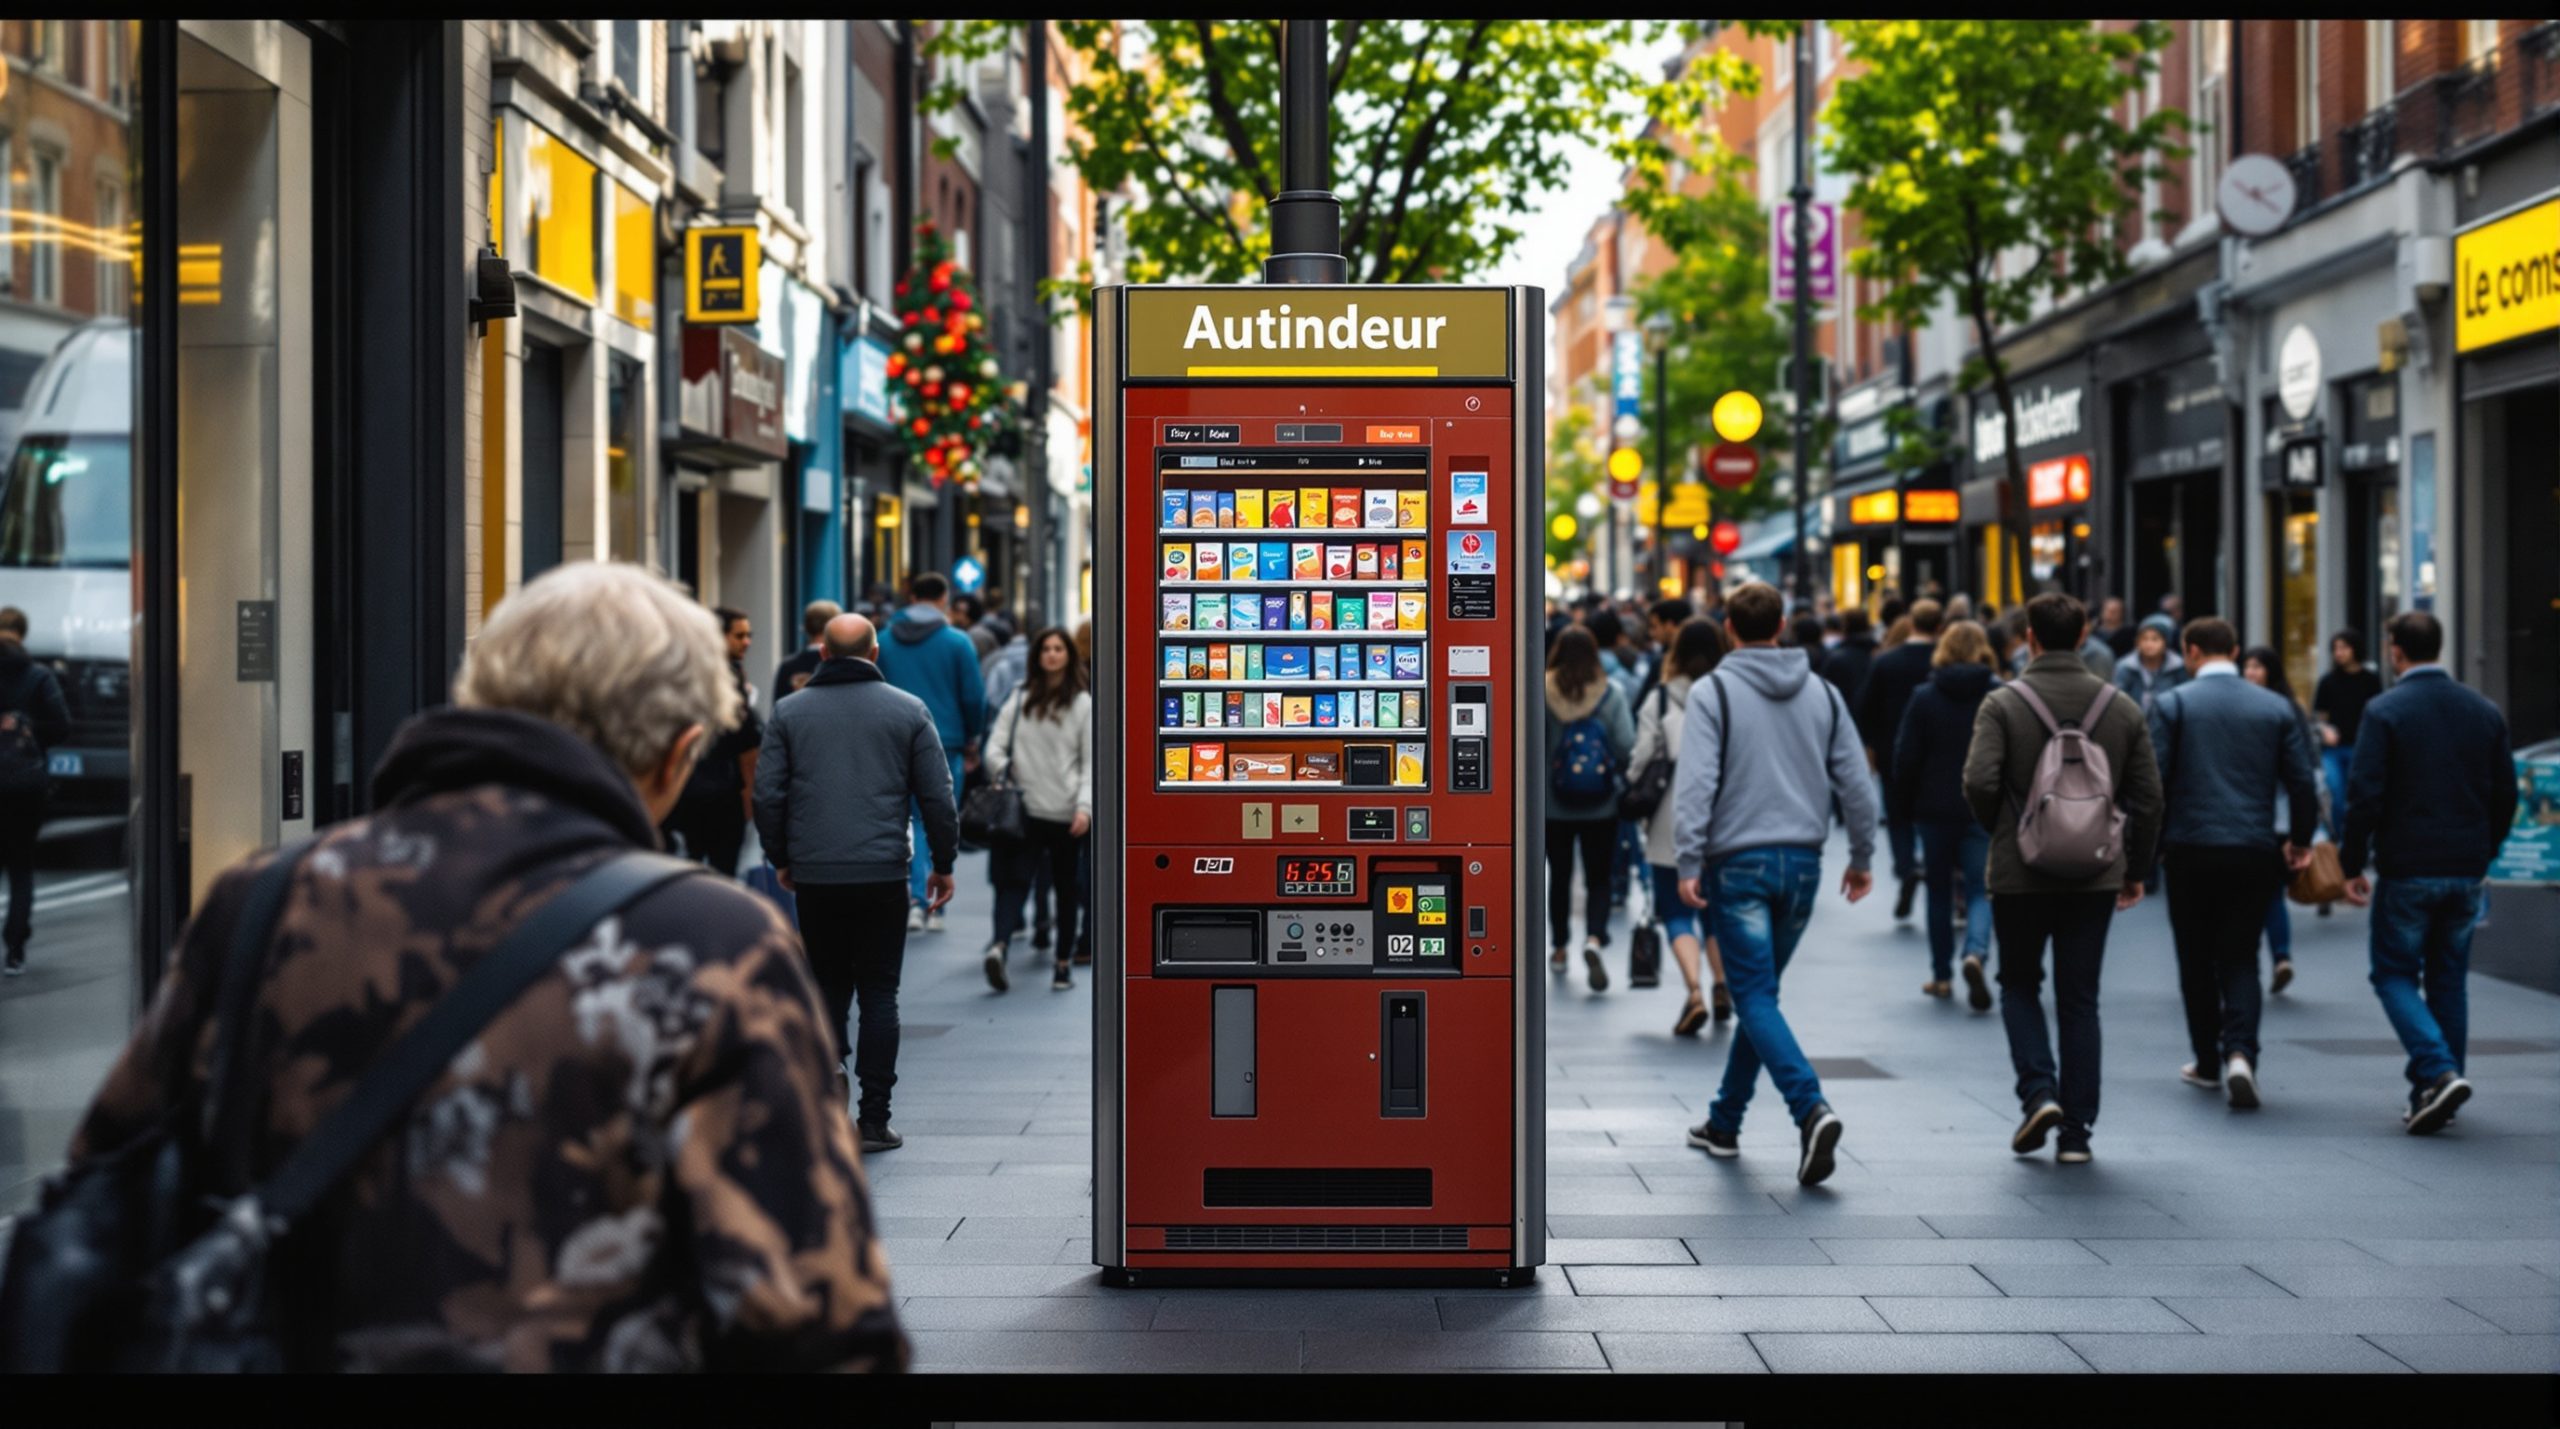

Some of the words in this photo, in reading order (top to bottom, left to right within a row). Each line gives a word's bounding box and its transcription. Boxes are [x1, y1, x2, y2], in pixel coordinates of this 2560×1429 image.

[2464, 257, 2491, 319] Le
[1183, 299, 1446, 350] Autindeur
[1391, 936, 1411, 954] 02
